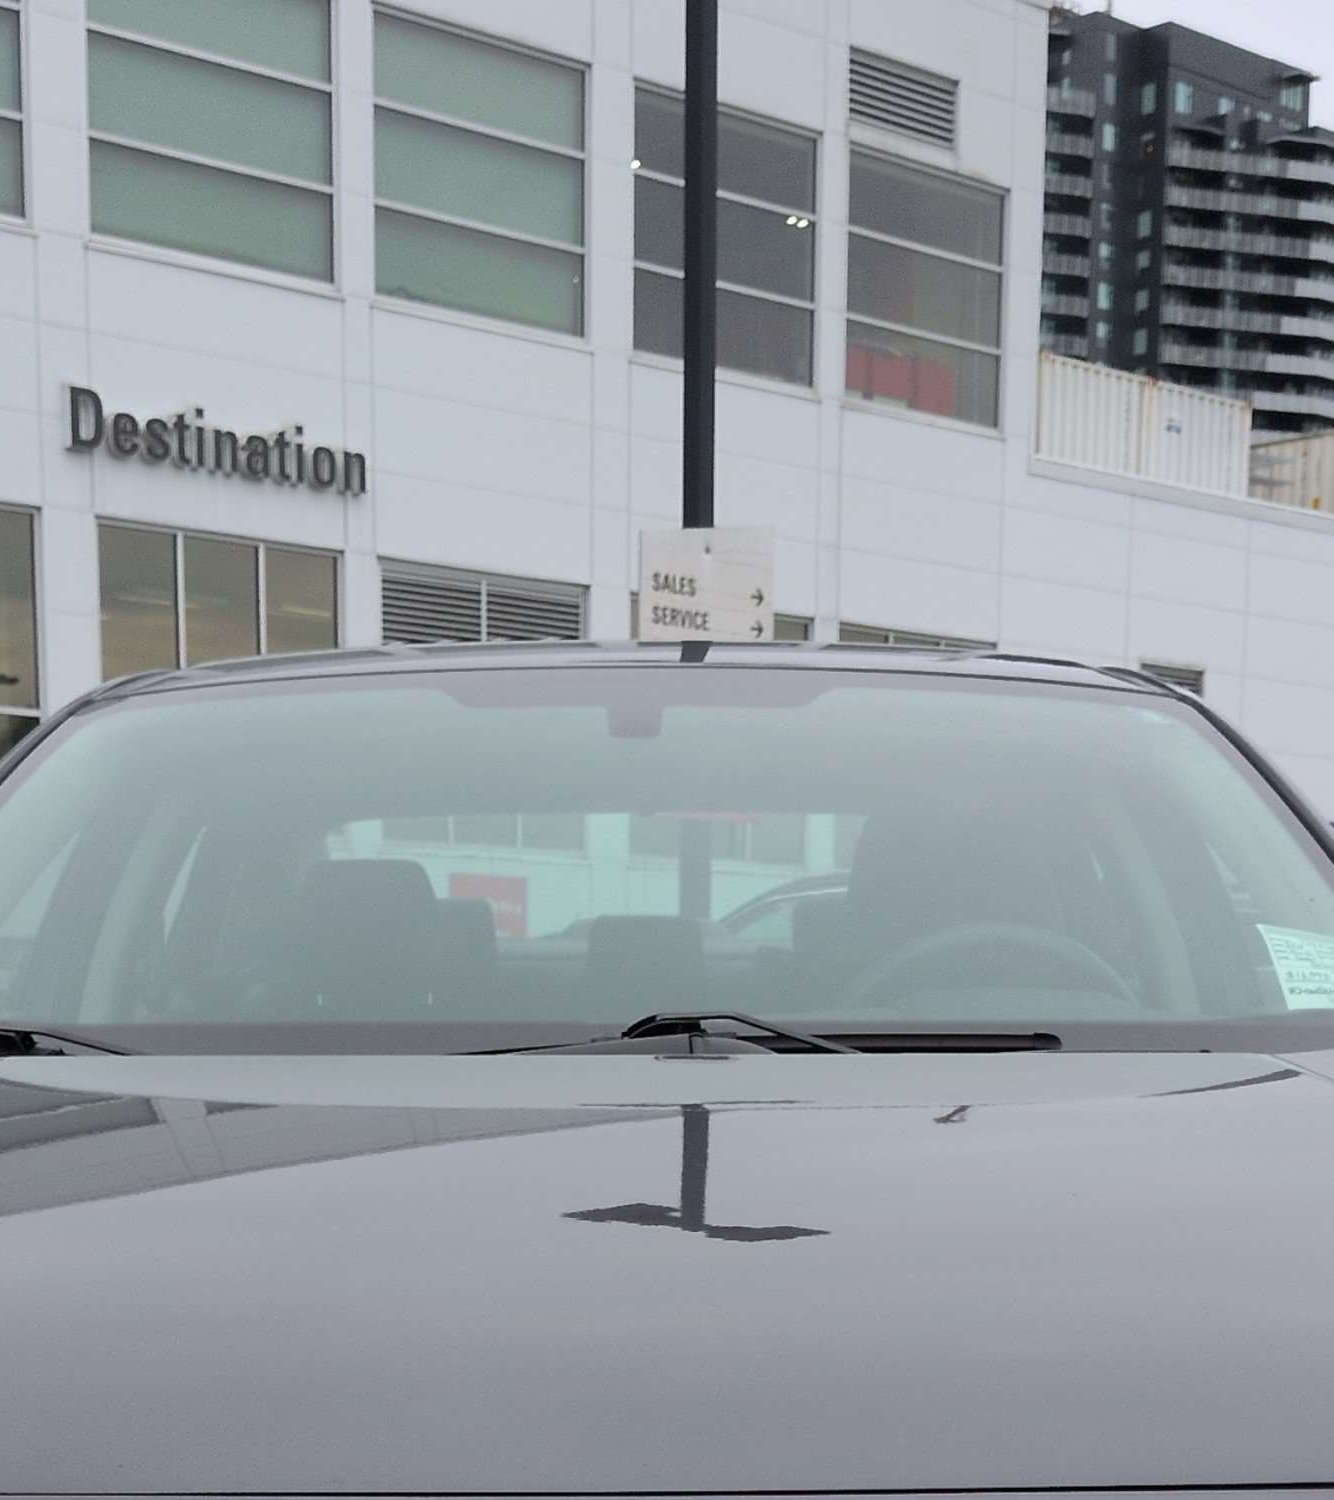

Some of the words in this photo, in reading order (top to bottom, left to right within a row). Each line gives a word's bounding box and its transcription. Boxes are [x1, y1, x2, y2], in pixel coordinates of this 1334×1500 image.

[67, 385, 366, 495] Destination
[651, 571, 696, 597] SALES
[651, 604, 710, 632] SERVICE
